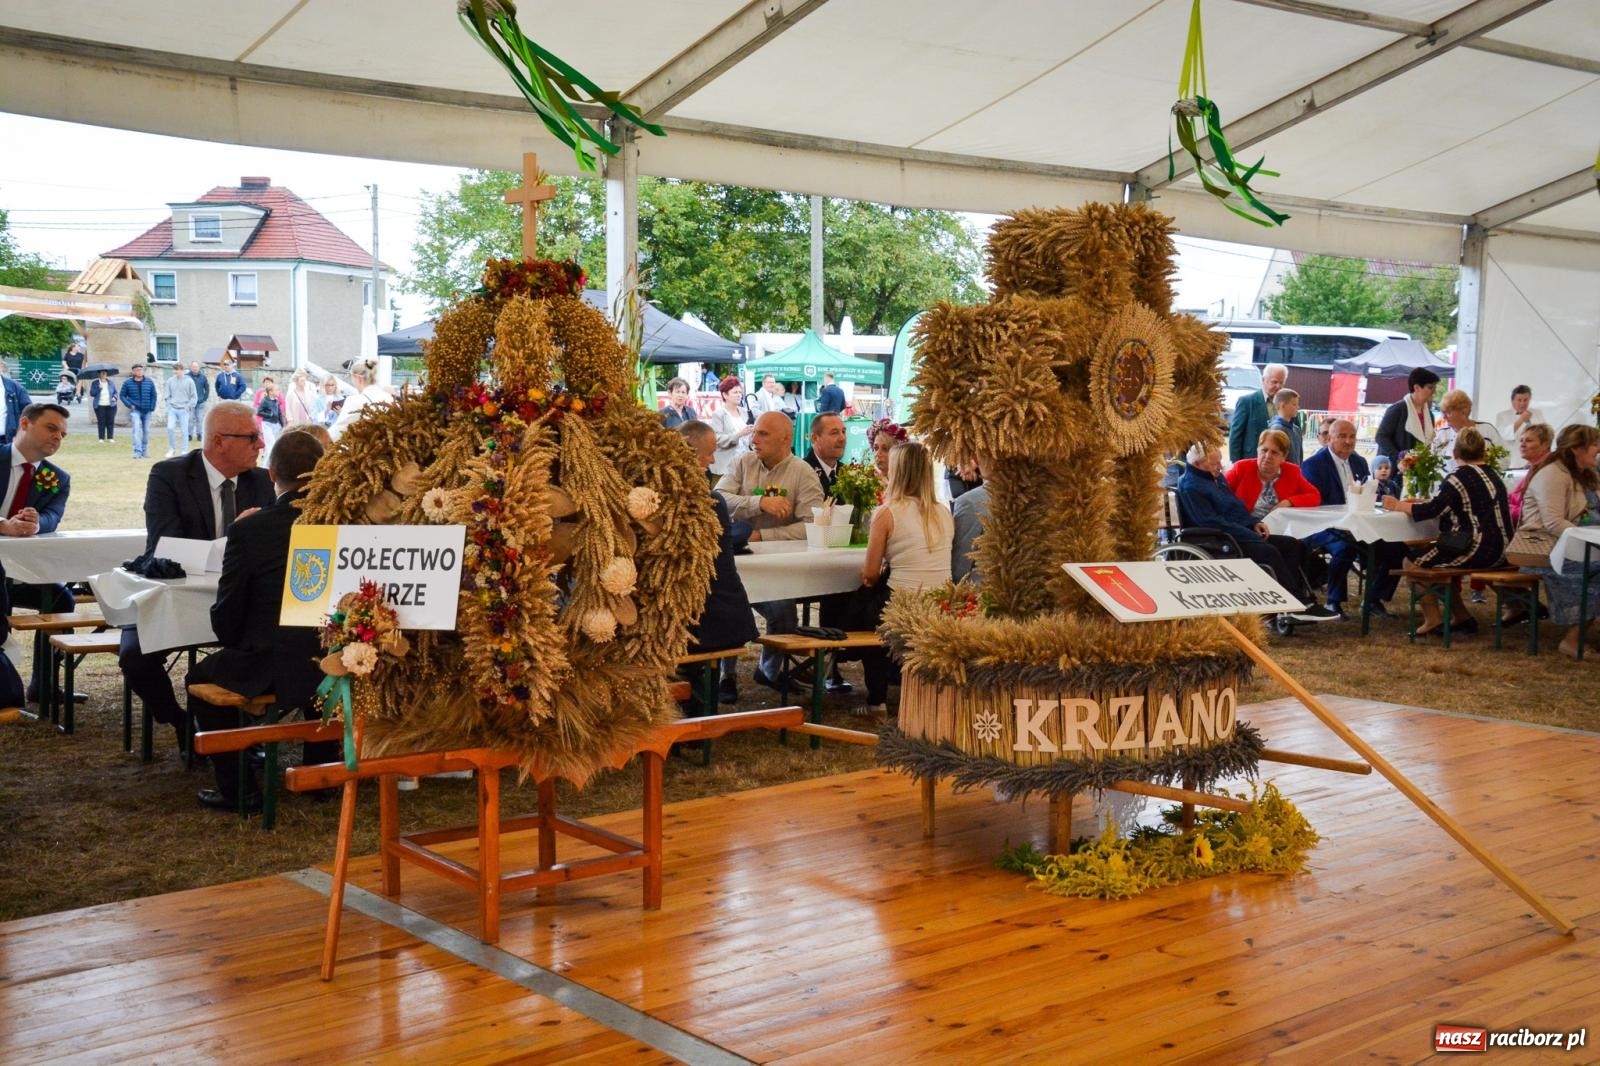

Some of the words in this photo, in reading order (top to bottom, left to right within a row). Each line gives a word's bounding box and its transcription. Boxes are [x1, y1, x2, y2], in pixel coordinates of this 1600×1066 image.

[337, 547, 456, 571] SOŁECTWO
[1165, 564, 1244, 585] GMINA
[1169, 587, 1287, 610] Krzanowice
[1013, 687, 1236, 753] KRZANO
